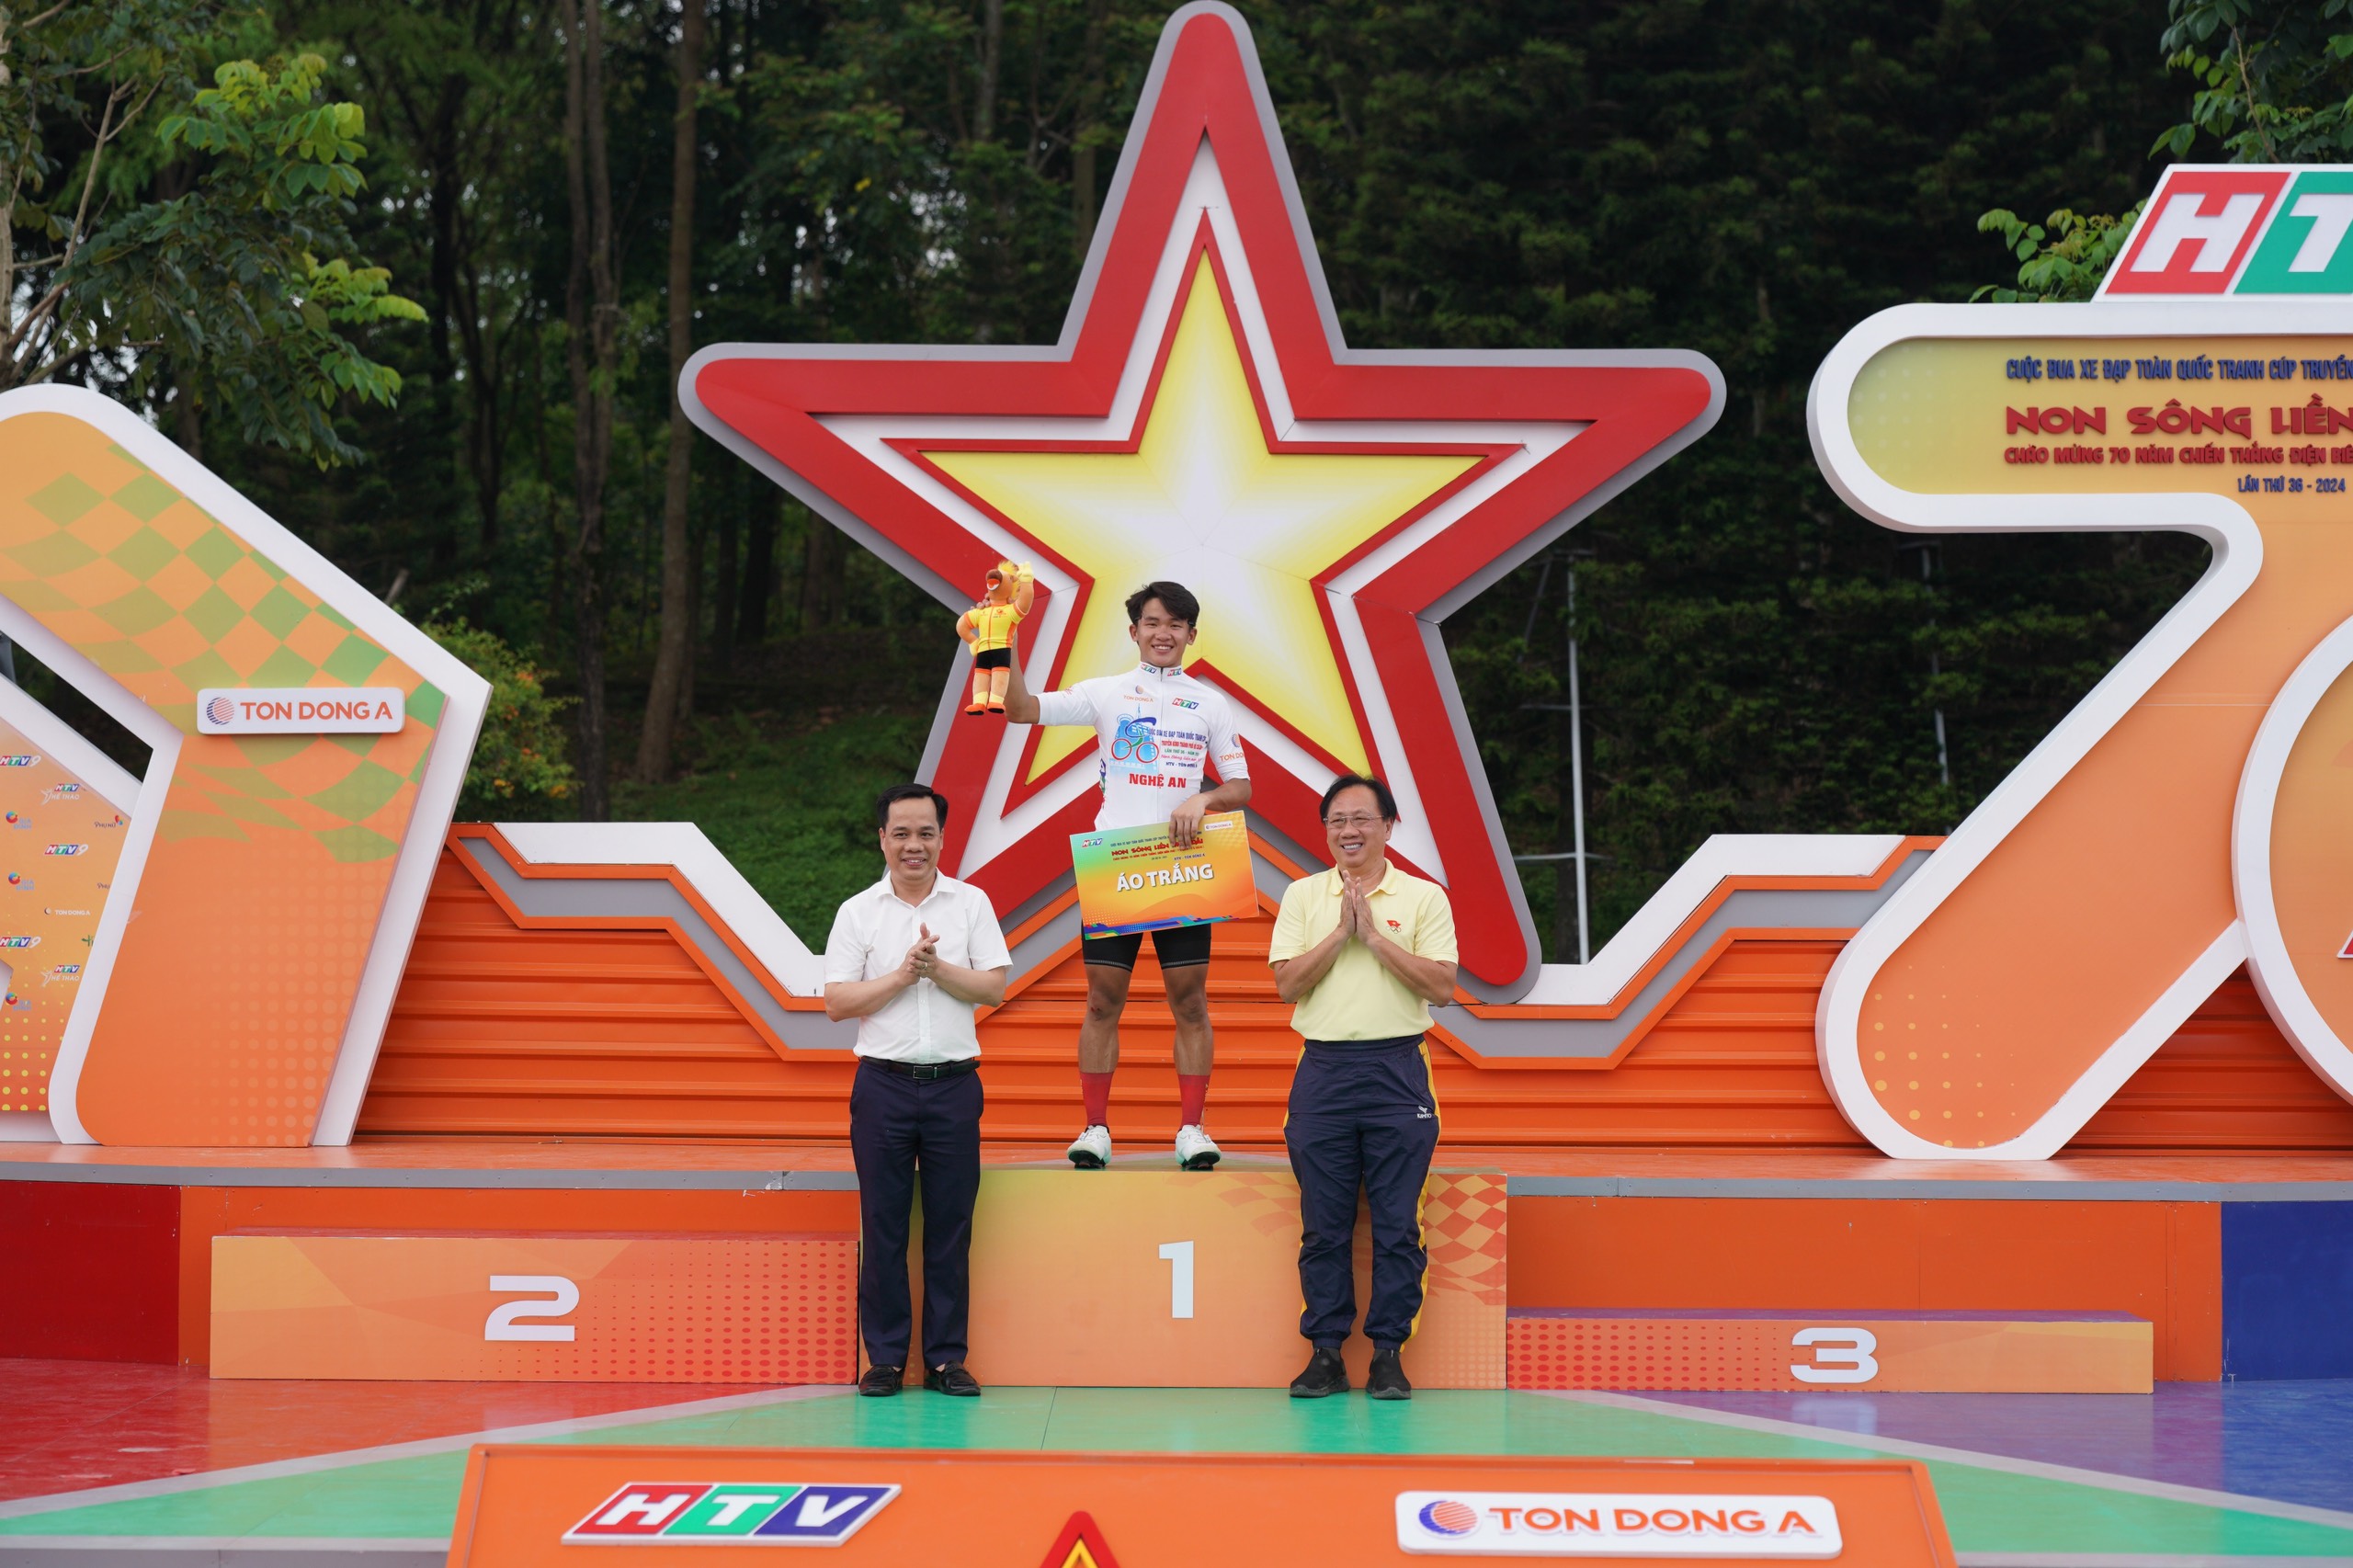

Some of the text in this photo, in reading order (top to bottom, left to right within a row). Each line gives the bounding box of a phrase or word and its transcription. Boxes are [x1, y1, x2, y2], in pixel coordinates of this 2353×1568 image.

[2006, 356, 2042, 383] CUỘC
[2047, 359, 2075, 379] ĐUA
[2080, 359, 2098, 379] XE
[2102, 359, 2131, 383] ĐẠP
[2135, 356, 2172, 379] TOÀN
[2177, 354, 2213, 381] QUỐC
[2218, 359, 2265, 380] TRANH
[2269, 357, 2297, 380] CÚP
[2006, 393, 2353, 439] NON SÔNG LIỀN
[2054, 443, 2104, 463] MỪNG
[2109, 447, 2131, 463] 70
[2135, 443, 2174, 463] NĂM
[2178, 442, 2224, 463] CHIẾN
[2229, 440, 2284, 463] THẮNG
[2290, 444, 2326, 467] ĐIỆN
[2289, 477, 2303, 493] 36
[2316, 477, 2346, 493] 2024
[240, 701, 392, 720] TON DONG A
[1173, 698, 1199, 710] HTV
[1219, 753, 1234, 761] TON
[1129, 773, 1187, 789] NGHỆ AN
[1083, 838, 1103, 847] HTV
[1117, 862, 1213, 892] ÁO TRẮNG
[1159, 1240, 1194, 1318] 1
[484, 1275, 580, 1341] 2
[1790, 1327, 1879, 1383] 3
[596, 1494, 869, 1527] HTV
[1490, 1507, 1815, 1533] TON DONG A
